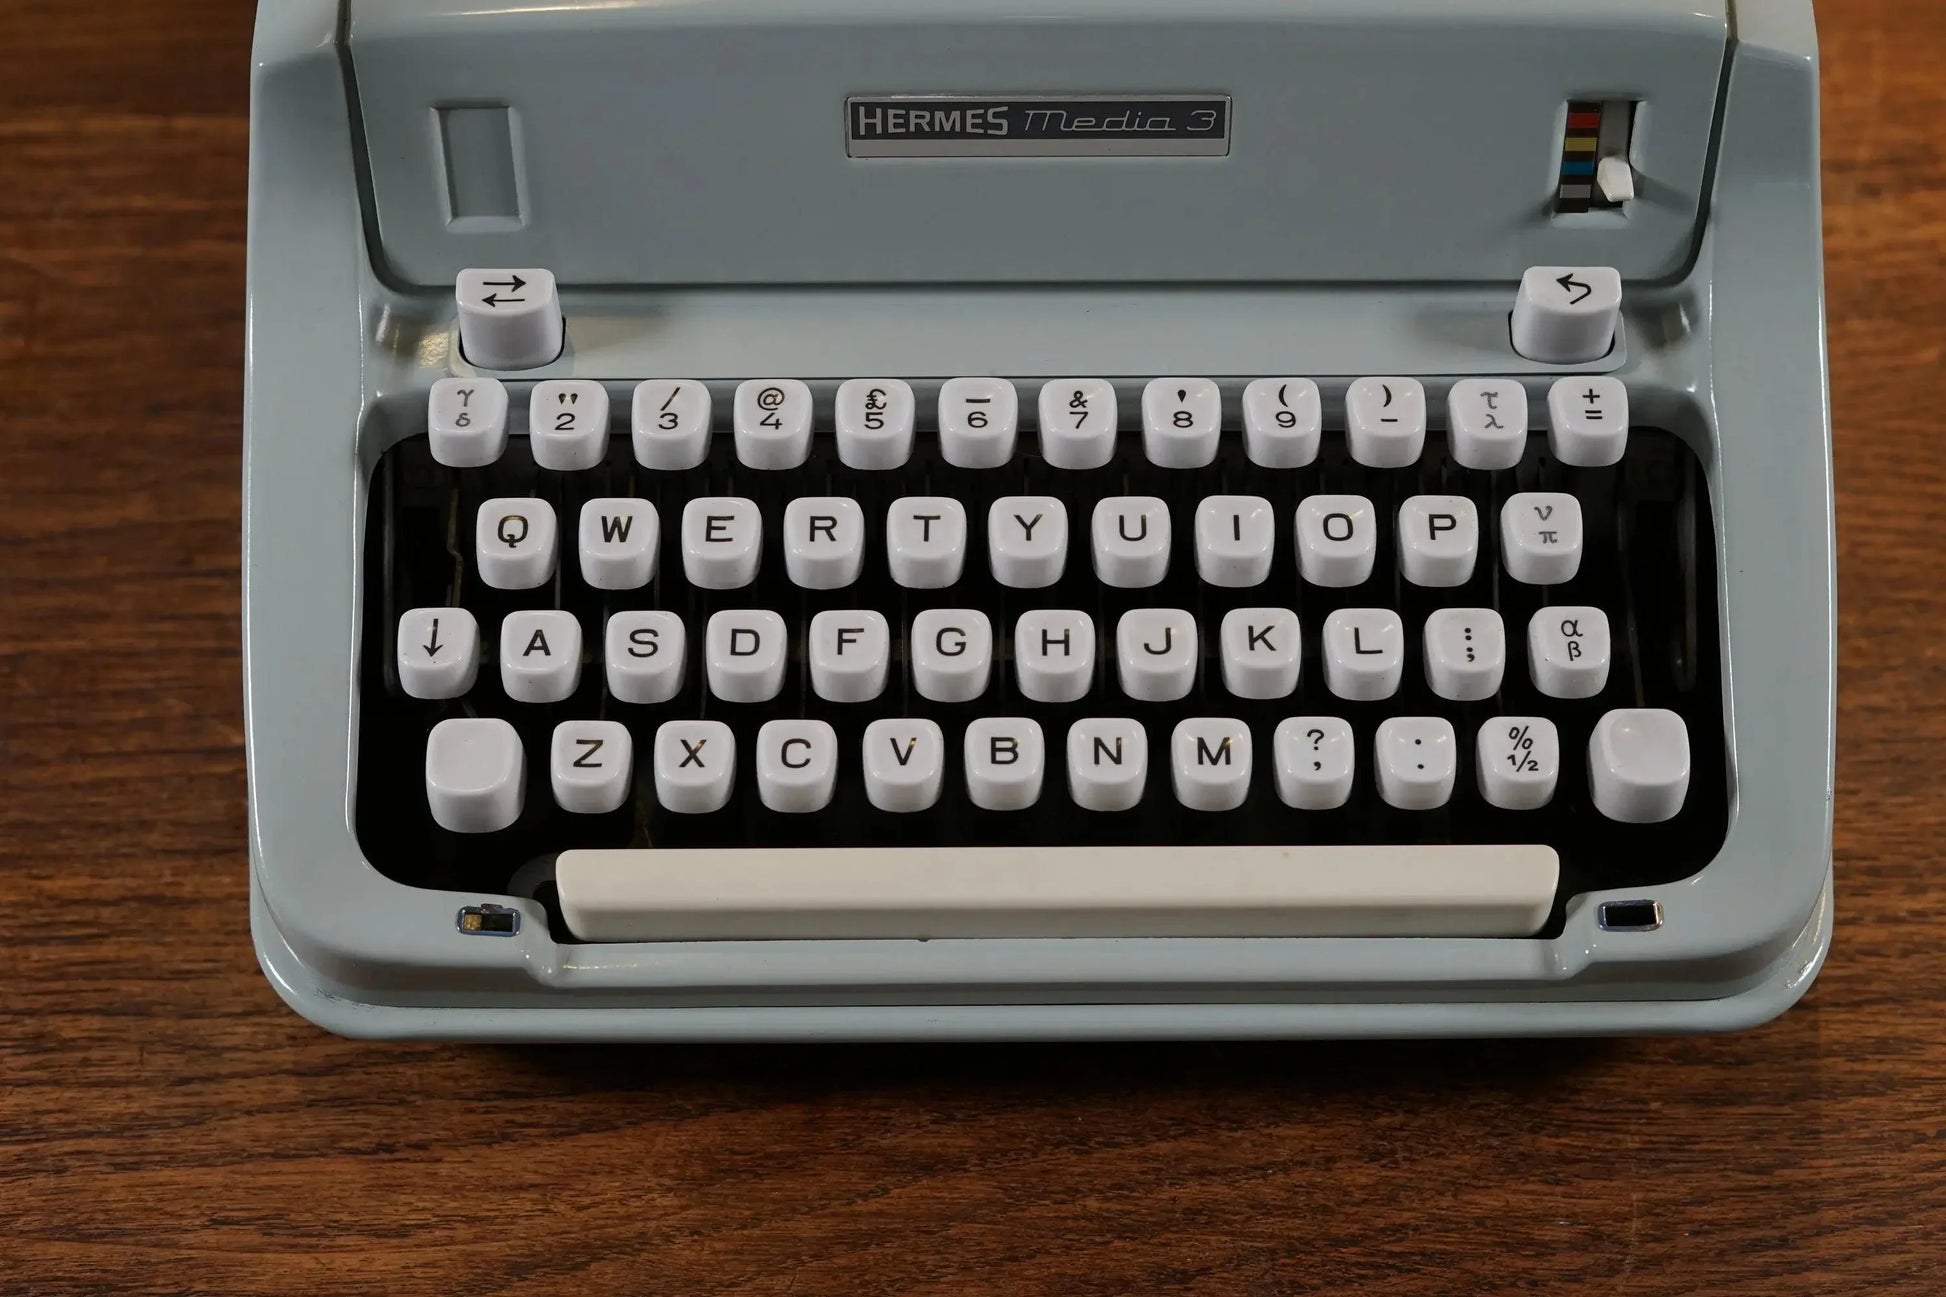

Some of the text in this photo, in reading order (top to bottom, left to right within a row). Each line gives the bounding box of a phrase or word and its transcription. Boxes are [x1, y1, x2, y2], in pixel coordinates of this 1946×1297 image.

[858, 105, 1217, 136] HERMES Media 3
[757, 386, 785, 411] @
[864, 388, 888, 410] £
[1069, 390, 1088, 409] &
[554, 412, 576, 431] 2
[658, 412, 679, 430] 3
[759, 412, 783, 430] 4
[864, 411, 885, 430] 5
[967, 411, 989, 429] 6
[1069, 411, 1089, 430] 7
[1172, 410, 1194, 429] 8
[1275, 410, 1297, 429] 9
[1484, 413, 1504, 430] λ
[497, 514, 529, 549] Q
[600, 515, 633, 543] W
[705, 515, 735, 543] E
[809, 515, 838, 543] R
[912, 514, 941, 543] T
[1013, 514, 1043, 542] Y
[1118, 514, 1147, 542] U
[1233, 514, 1241, 542] I
[1322, 512, 1354, 542] O
[1428, 513, 1457, 541] P
[1538, 530, 1558, 544] π
[729, 628, 761, 657] D
[836, 627, 865, 656] F
[935, 626, 967, 657] G
[1041, 628, 1070, 657] H
[1143, 627, 1172, 656] J
[1247, 625, 1277, 652] K
[1353, 627, 1384, 655] L
[1560, 619, 1584, 638] α
[522, 629, 552, 657] A
[627, 628, 659, 658] S
[1567, 640, 1582, 662] β
[889, 737, 917, 767] V
[990, 736, 1019, 765] B
[1093, 736, 1123, 766] N
[1196, 736, 1232, 766] M
[1306, 728, 1325, 751] ?
[1508, 726, 1534, 751] %
[572, 738, 604, 768] Z
[678, 738, 707, 768] X
[780, 737, 812, 769] C
